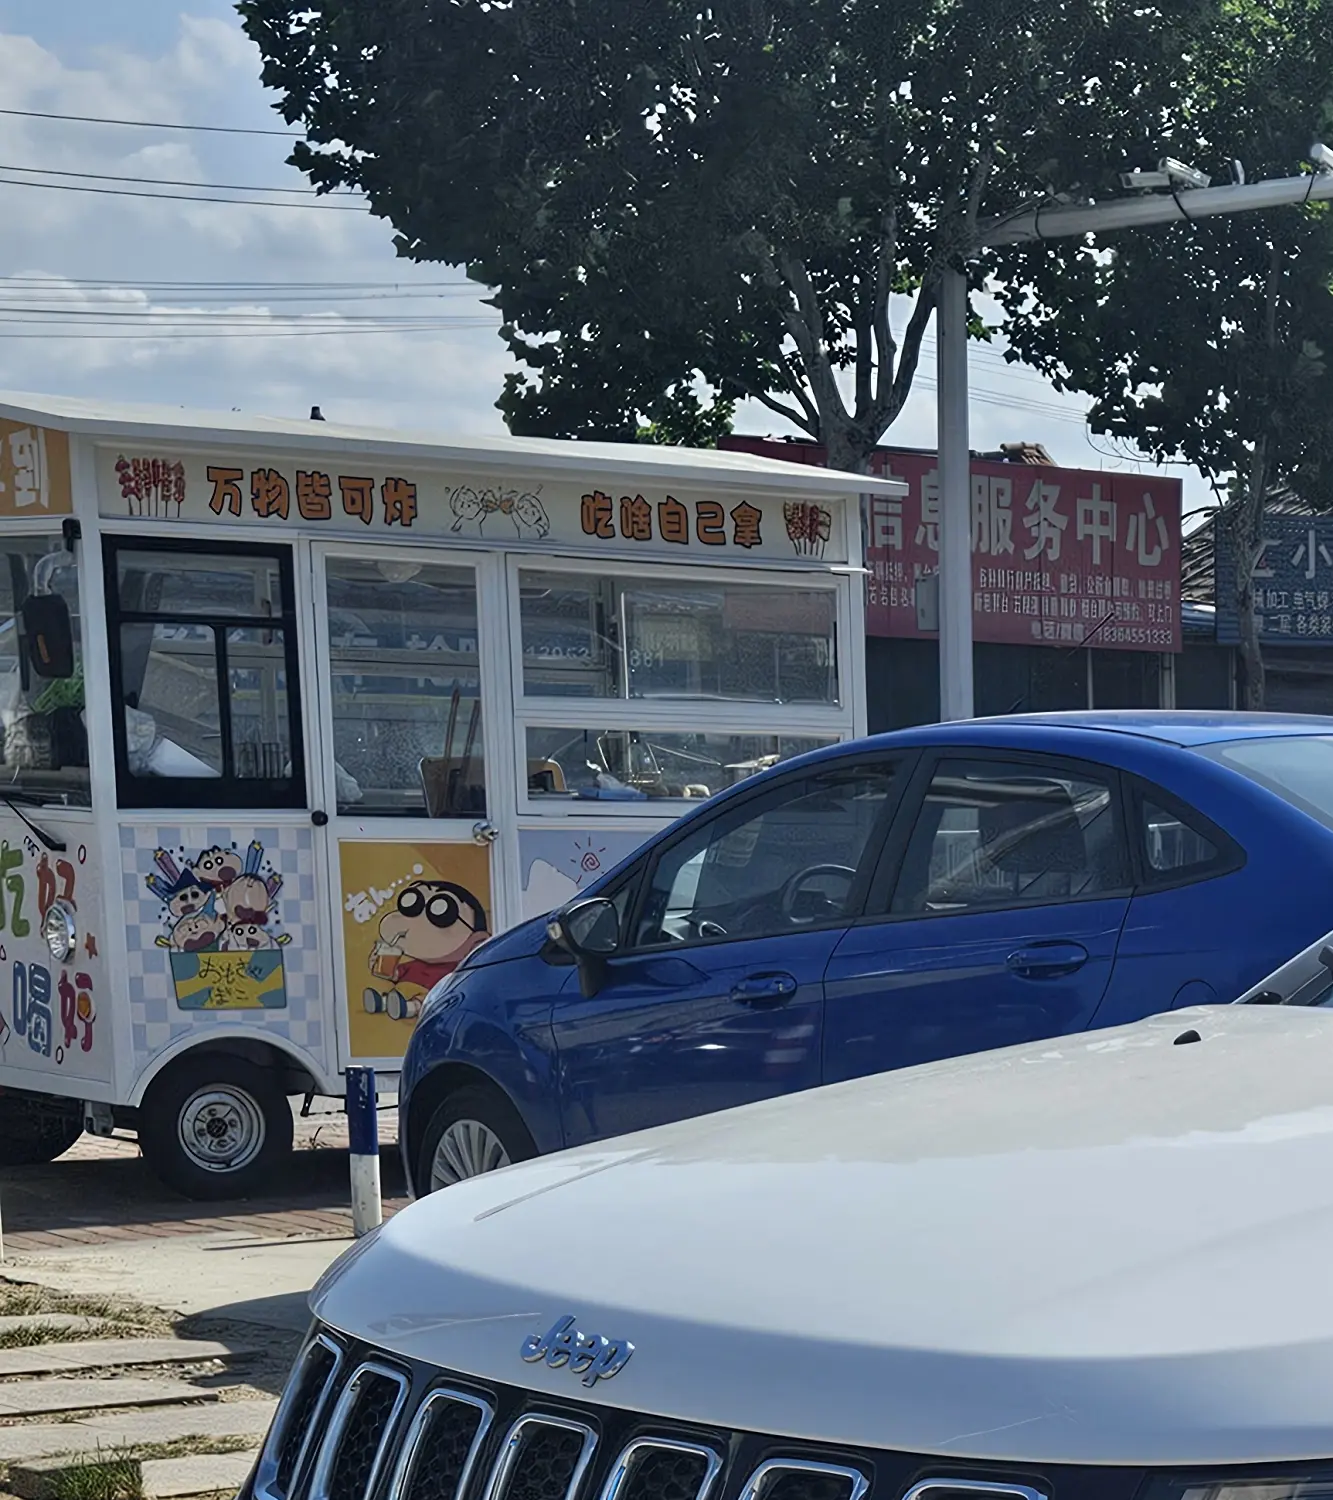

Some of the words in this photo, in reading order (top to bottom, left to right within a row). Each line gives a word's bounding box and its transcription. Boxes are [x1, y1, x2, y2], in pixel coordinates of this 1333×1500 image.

[206, 465, 418, 527] 万物皆可炸
[581, 490, 763, 549] 吃啥自己拿
[520, 1314, 636, 1388] Jeep
